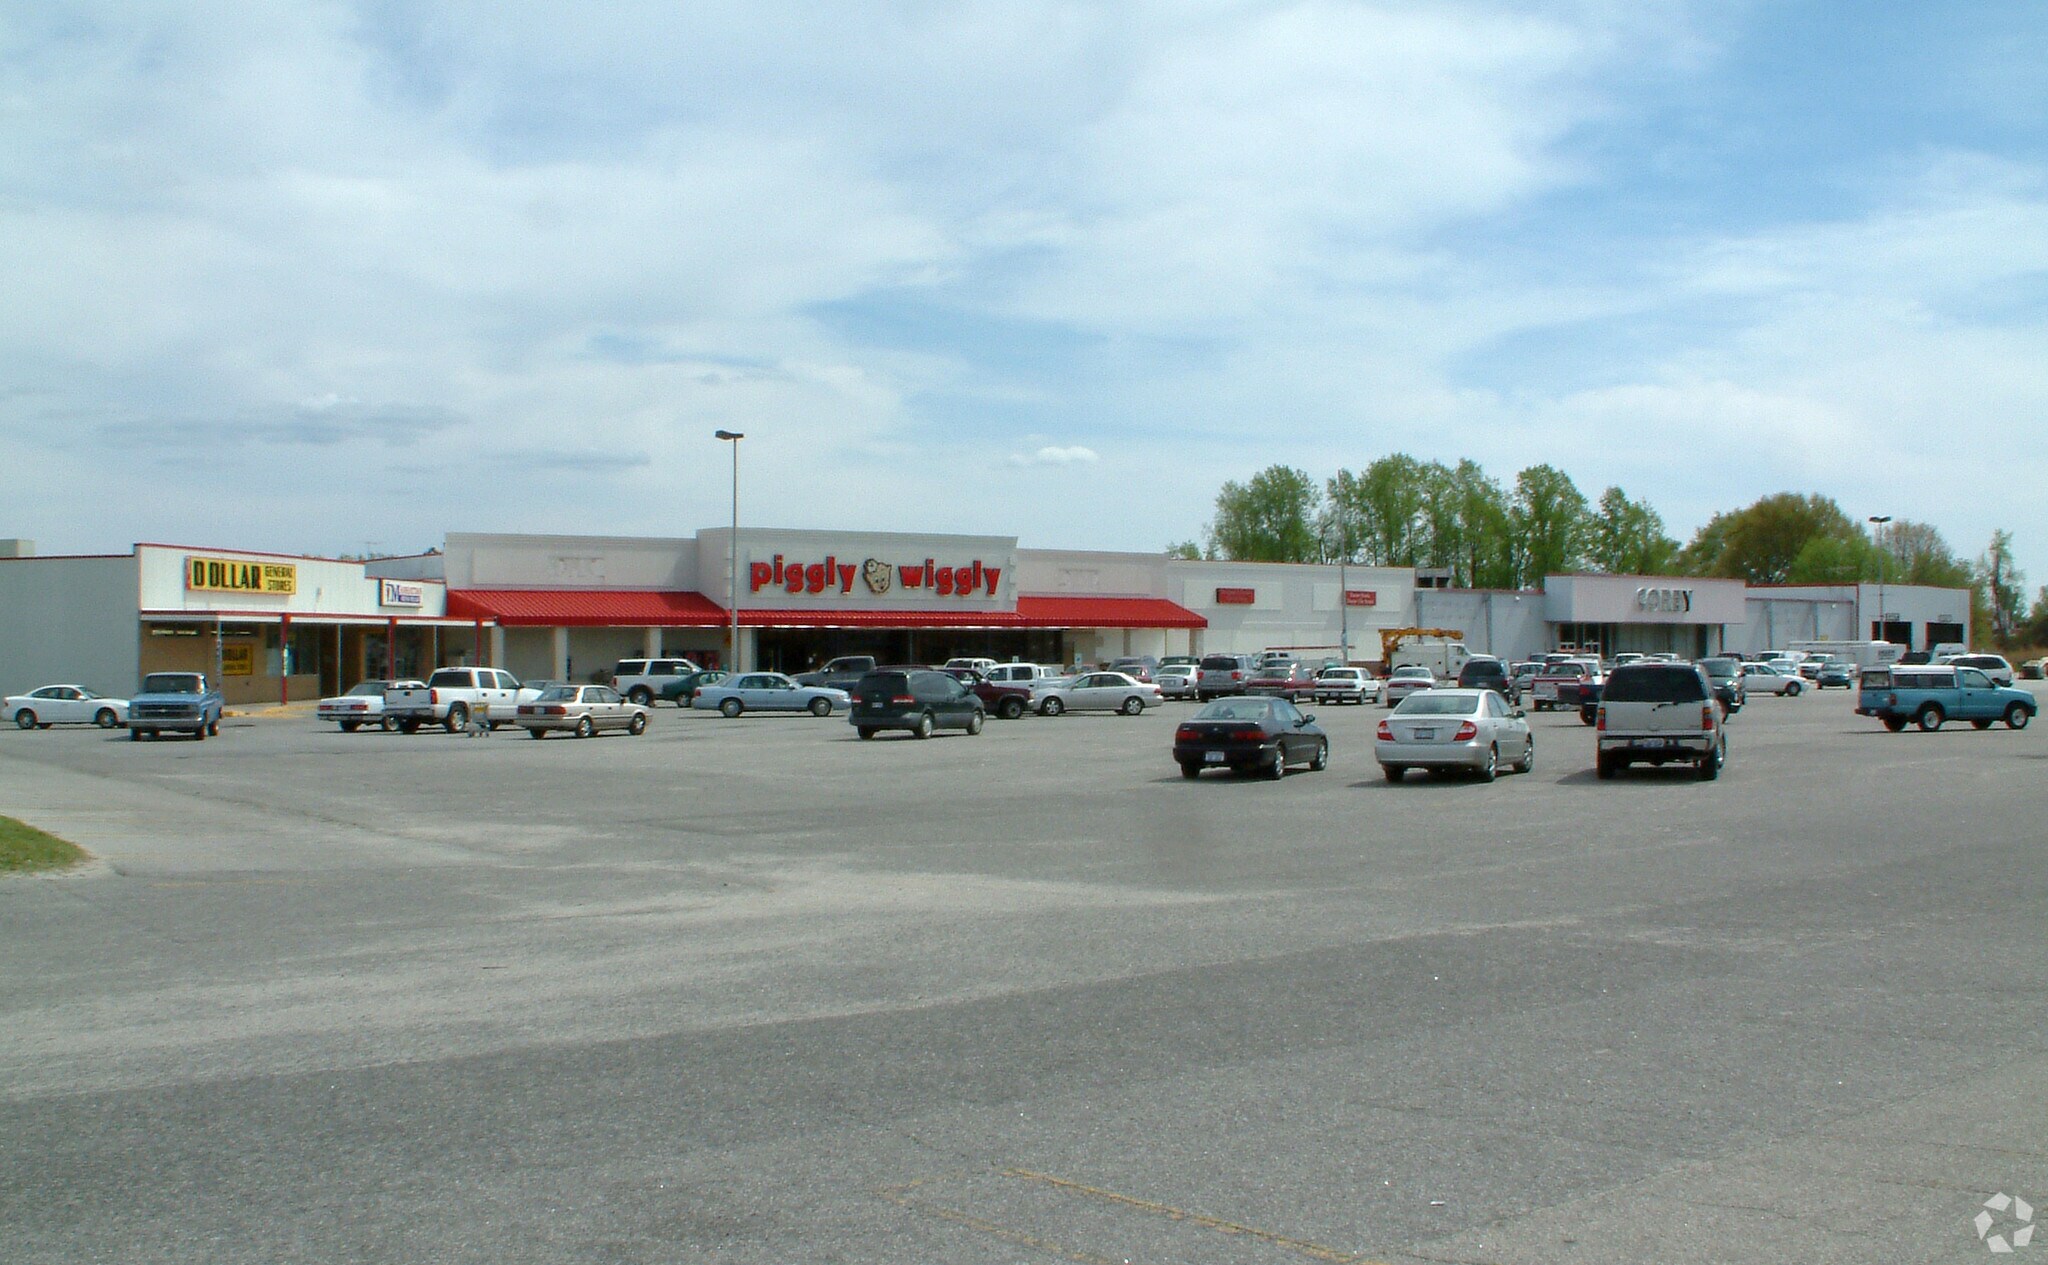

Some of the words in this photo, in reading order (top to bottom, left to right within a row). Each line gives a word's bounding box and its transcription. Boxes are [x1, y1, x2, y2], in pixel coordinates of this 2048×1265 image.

[193, 560, 261, 589] DOLLAR
[265, 565, 292, 577] GENERAL
[750, 554, 857, 594] piggly
[899, 558, 1001, 596] wiggly
